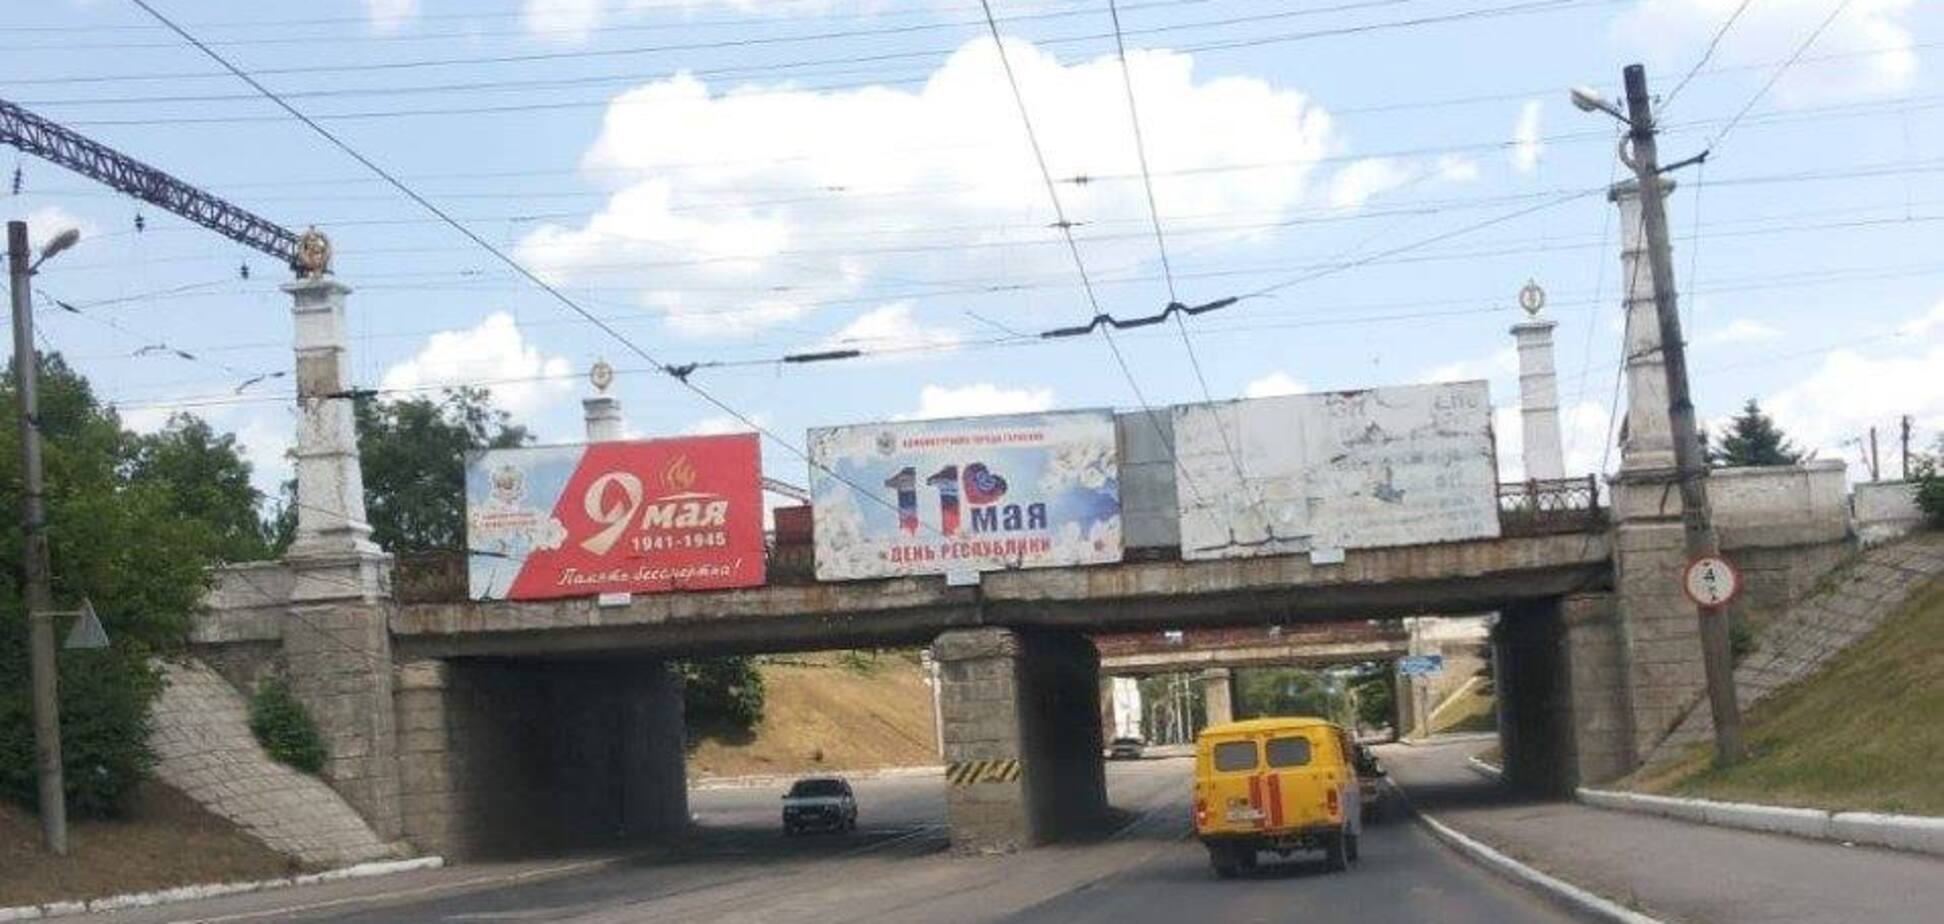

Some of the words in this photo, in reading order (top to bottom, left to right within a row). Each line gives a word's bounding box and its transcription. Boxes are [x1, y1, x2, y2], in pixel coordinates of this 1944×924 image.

[580, 471, 643, 555] 9
[641, 501, 729, 531] мая
[884, 466, 959, 537] 11
[632, 532, 727, 552] 1941-1945
[890, 546, 935, 563] ДЕНЬ
[941, 537, 1051, 560] РЕСПУБЛИКИ
[557, 568, 629, 586] Память
